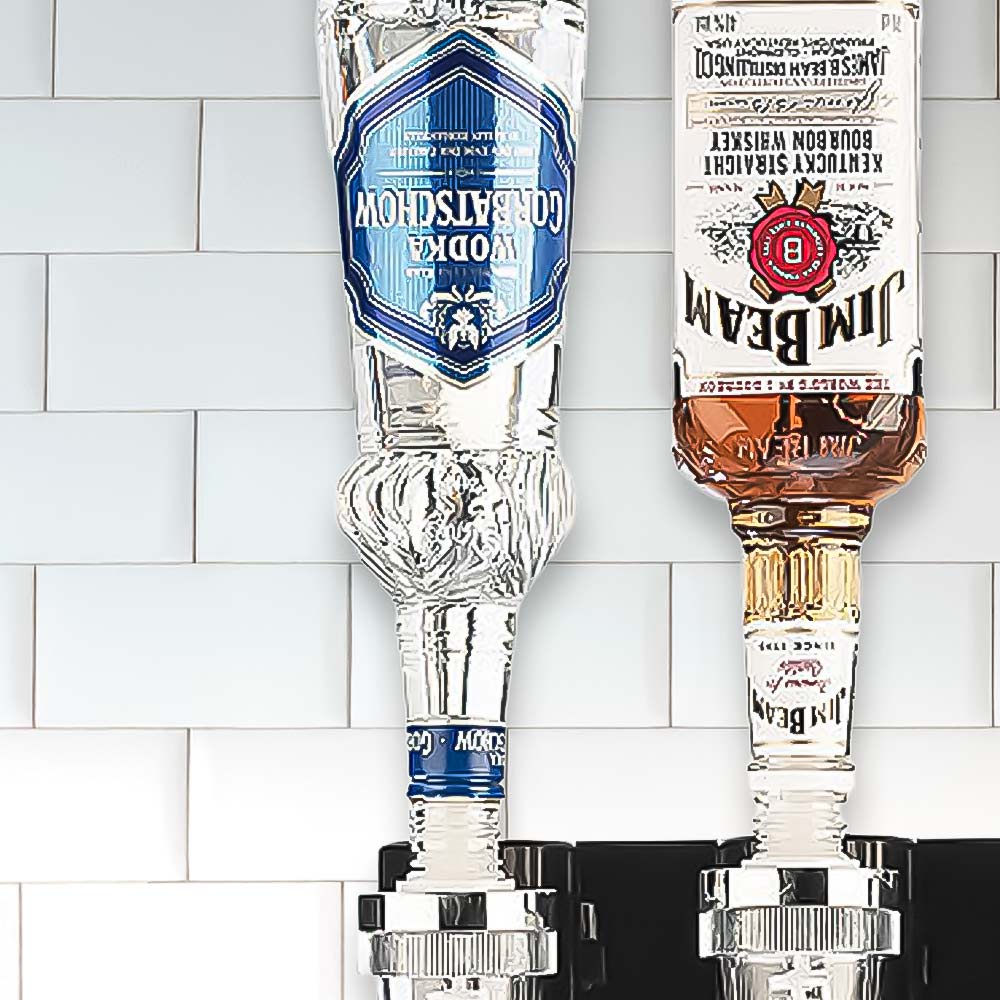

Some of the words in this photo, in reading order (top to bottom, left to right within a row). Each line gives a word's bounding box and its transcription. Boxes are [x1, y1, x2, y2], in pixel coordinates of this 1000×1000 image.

[709, 129, 787, 152] WHISKEY
[793, 129, 873, 151] BOURBON
[703, 152, 788, 176] STRAIGHT
[793, 153, 883, 174] KENTUCKY
[354, 188, 563, 234] GORBATSCHOW
[406, 234, 517, 262] WODKA
[682, 268, 812, 366] BEAM
[817, 269, 905, 350] JIM
[809, 686, 847, 727] JIM
